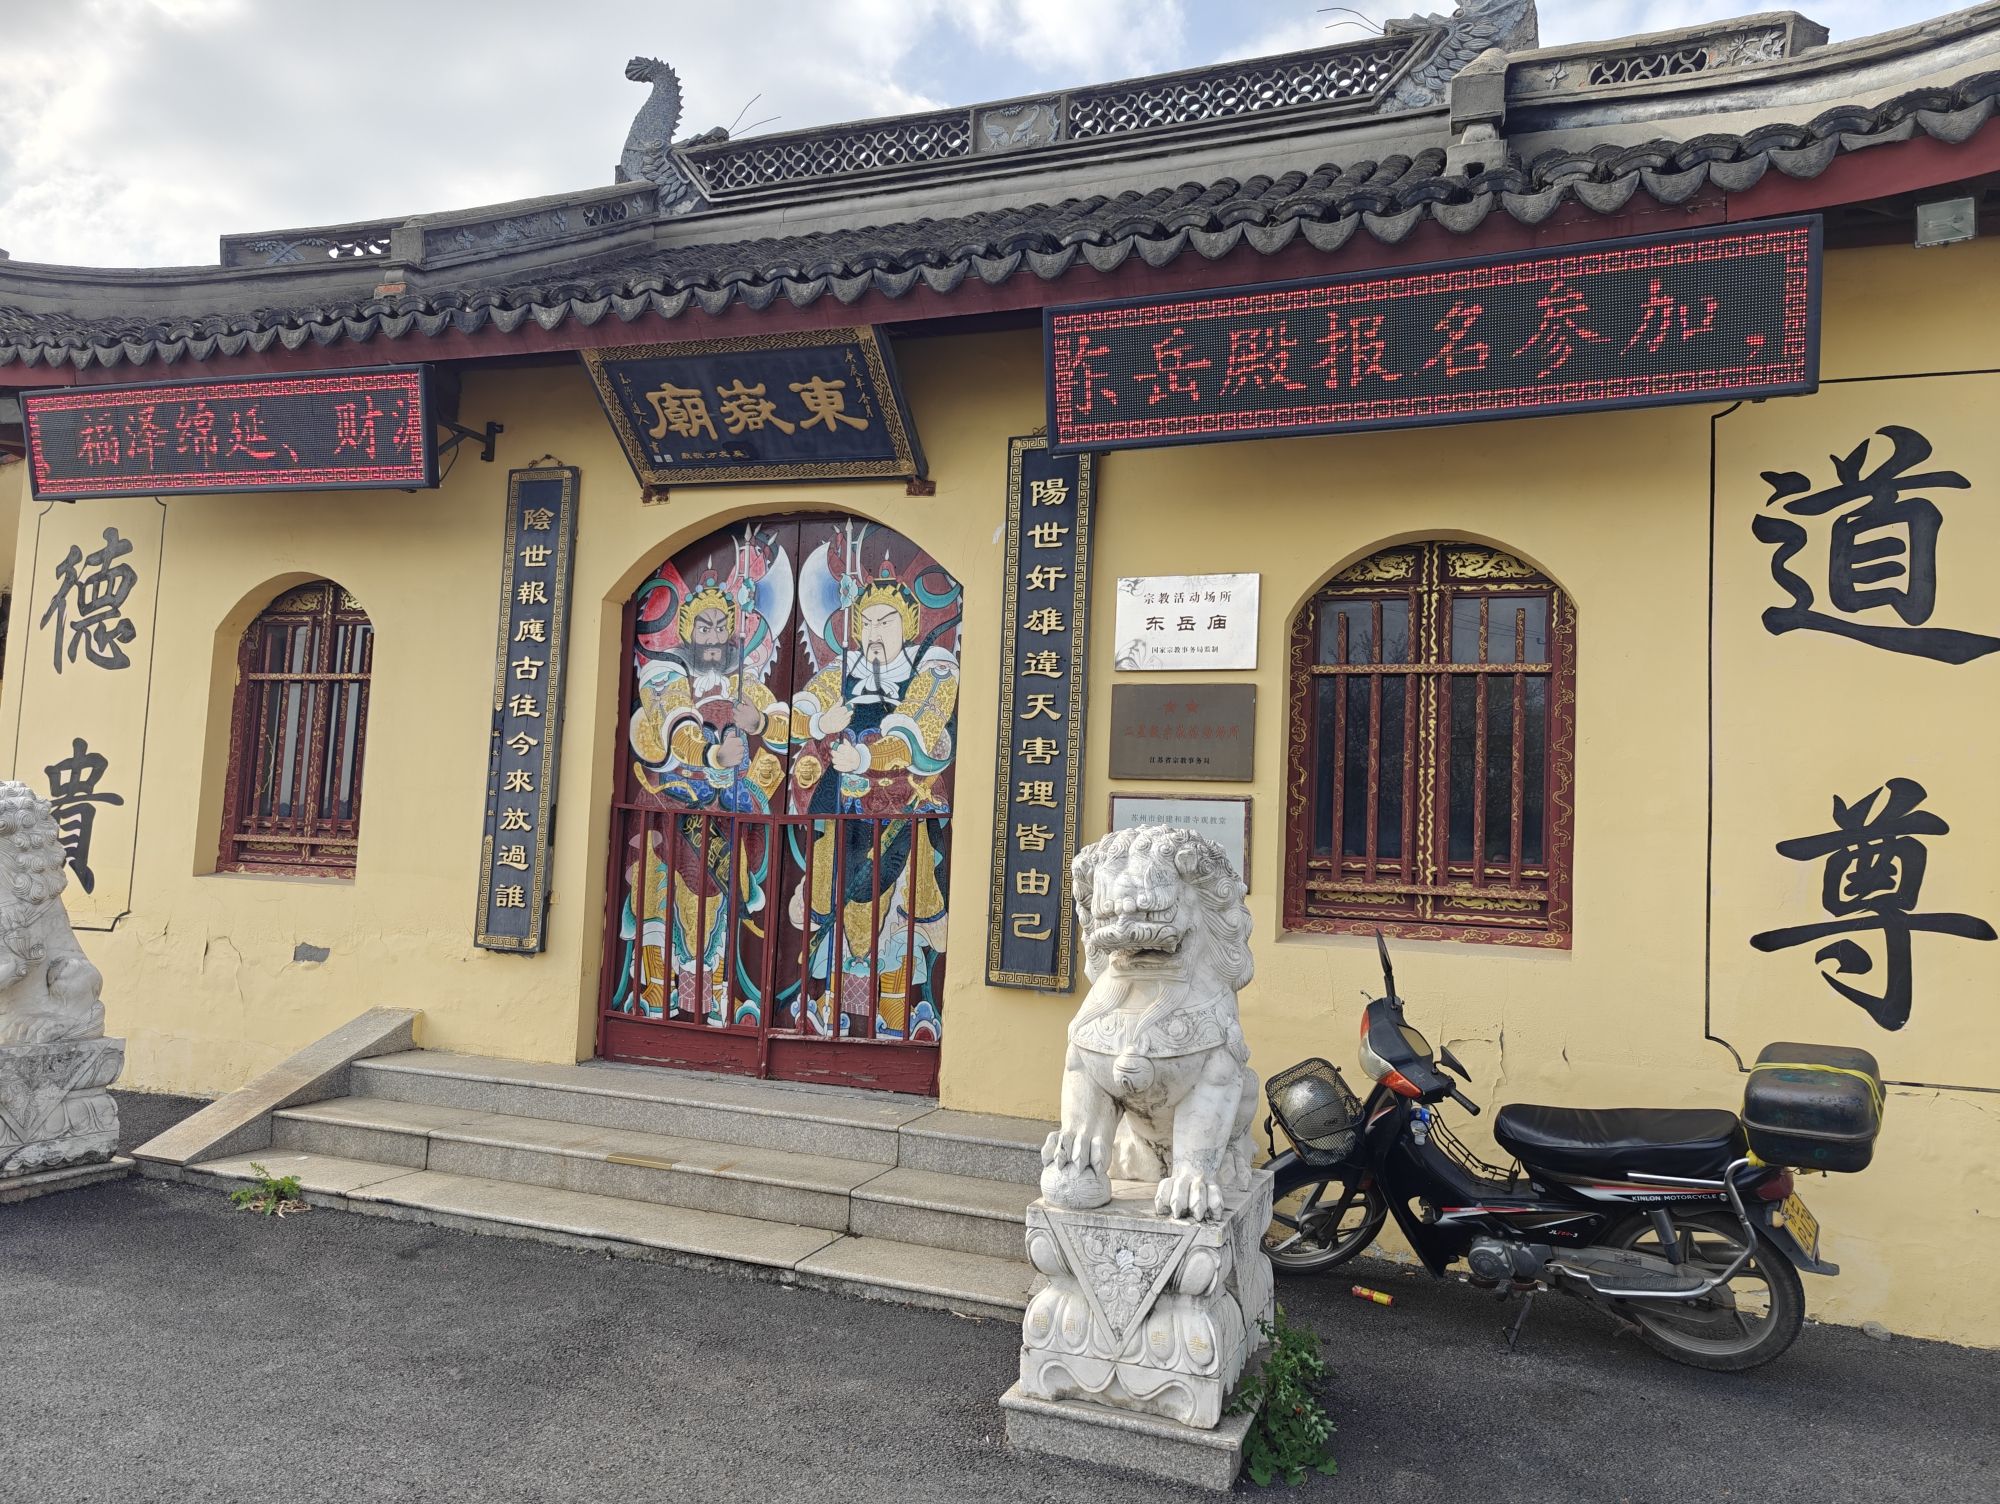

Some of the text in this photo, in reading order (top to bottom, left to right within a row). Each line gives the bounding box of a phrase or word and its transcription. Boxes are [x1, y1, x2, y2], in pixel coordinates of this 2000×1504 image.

[1143, 591, 1232, 605] 宗教活动场所
[1145, 614, 1228, 632] 东岳庙
[1750, 424, 2000, 1032] 道尊
[1664, 1193, 1717, 1202] MOTORCYCLE
